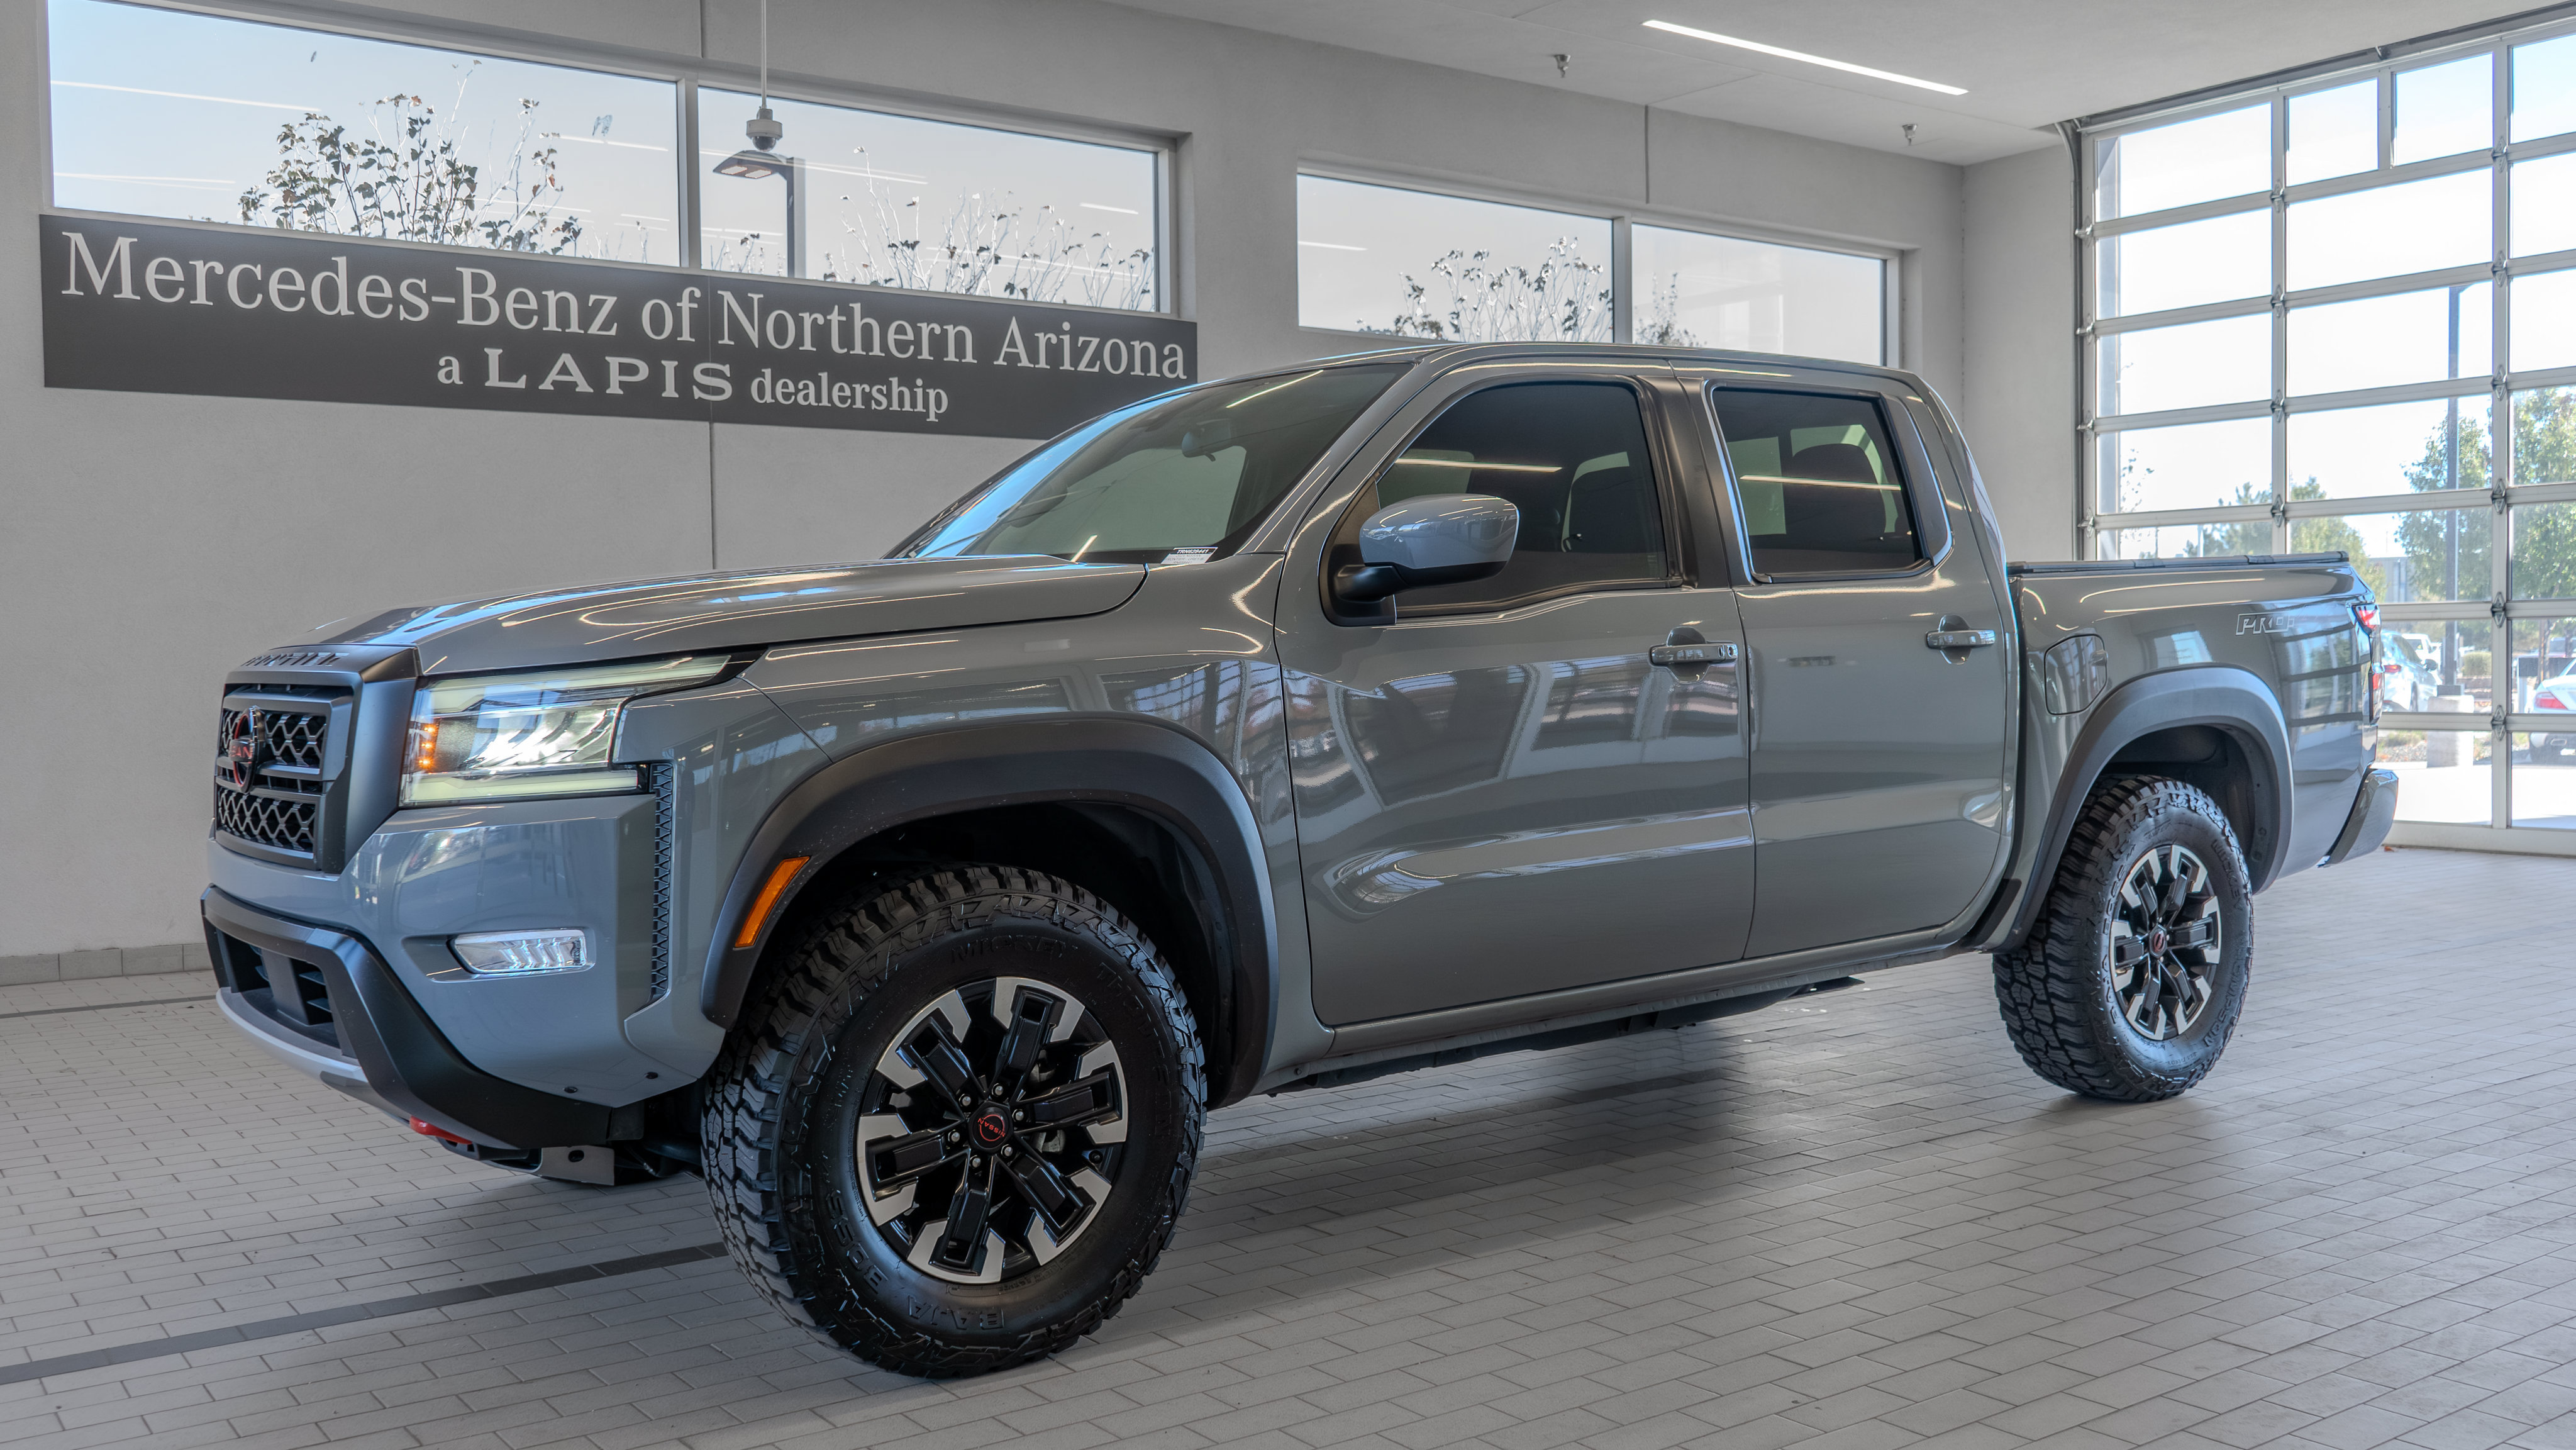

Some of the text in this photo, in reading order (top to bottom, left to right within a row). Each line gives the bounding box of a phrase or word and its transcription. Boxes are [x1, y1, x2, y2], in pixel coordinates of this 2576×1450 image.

[61, 231, 1187, 380] Mercedes-Benz of Northern Arizona
[437, 347, 948, 422] a LAPIS dealership
[977, 1118, 1006, 1137] NISSAN
